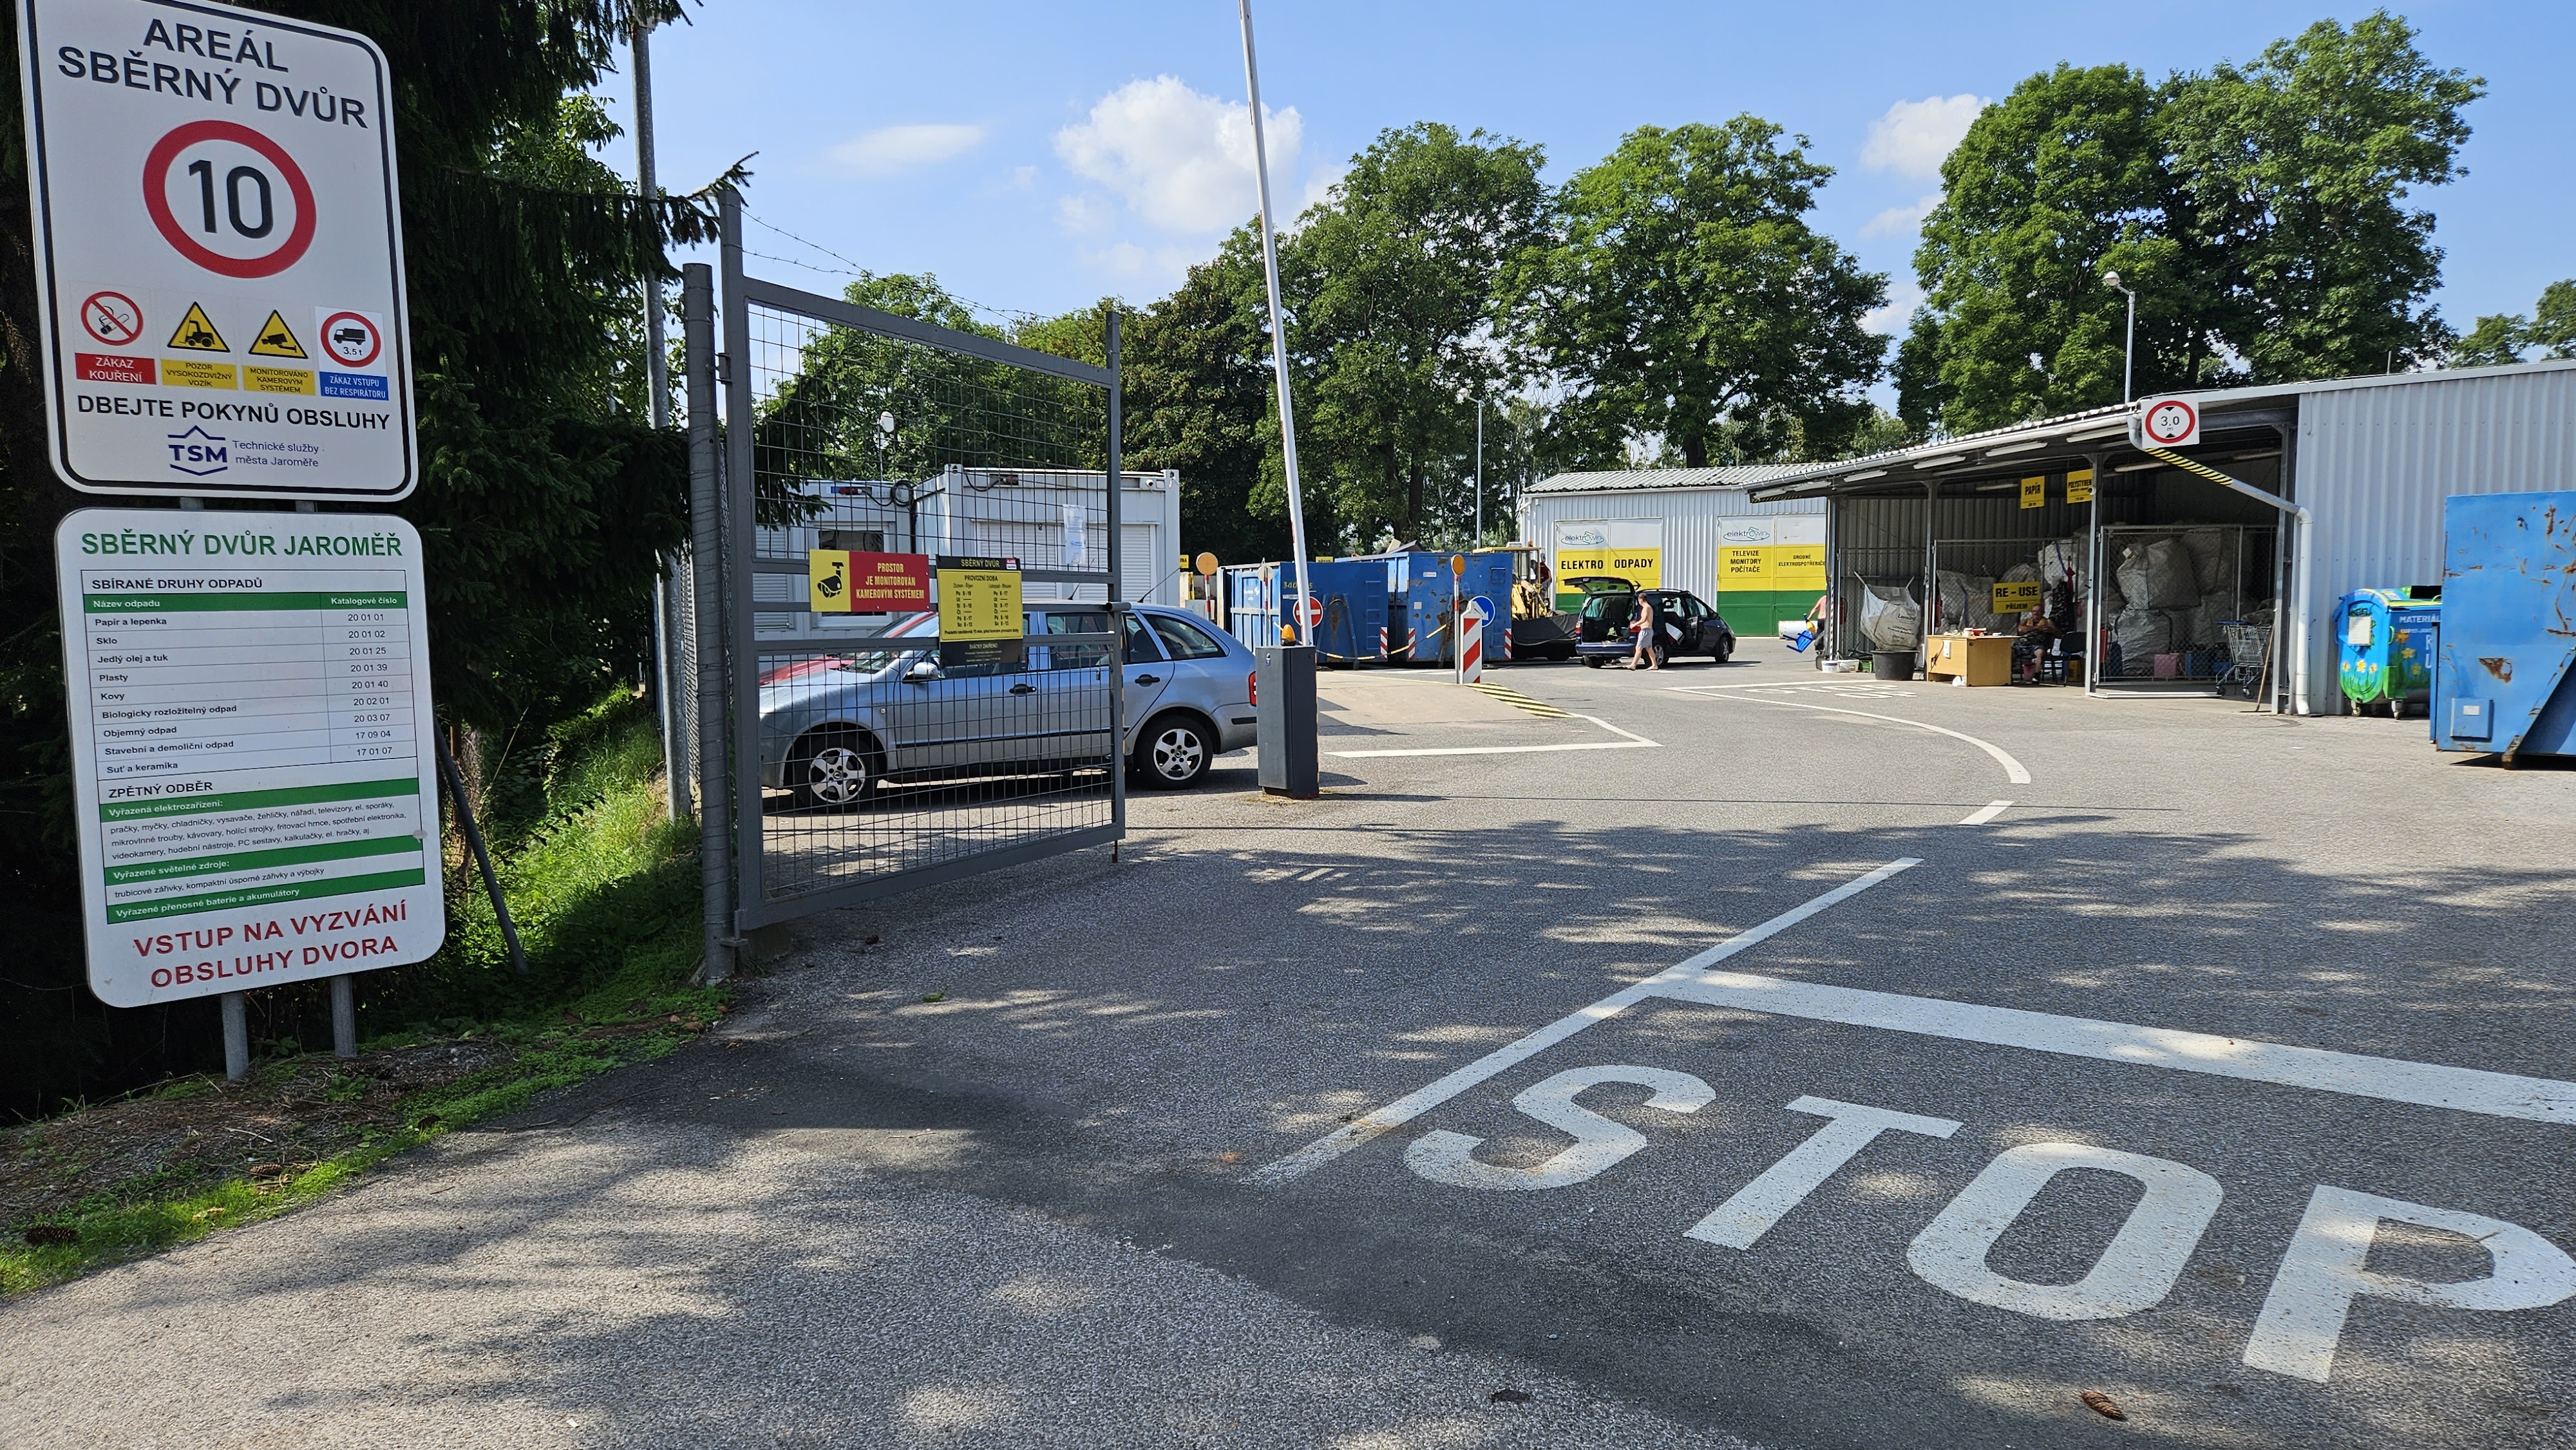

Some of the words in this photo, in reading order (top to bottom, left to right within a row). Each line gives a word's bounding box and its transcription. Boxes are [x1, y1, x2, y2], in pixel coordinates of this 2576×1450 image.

[143, 18, 288, 73] AREÁL
[58, 46, 241, 105] SBĚRNÝ
[256, 81, 368, 129] DVŮR
[189, 160, 273, 239] 10
[343, 346, 357, 355] 3.5
[96, 357, 134, 369] ZÁKAZ
[89, 370, 142, 382] KOUŘENÍ
[166, 370, 232, 380] VYSOKOZDVIŽNÝ
[250, 368, 308, 378] MONITOROVÁNO
[257, 376, 303, 385] KAMEROVÝM
[330, 375, 351, 385] ZÁKAZ
[353, 378, 379, 387] VSTUPU
[260, 384, 301, 393] SYSTÉMEM
[325, 387, 338, 395] BEZ
[340, 388, 385, 398] RESPIRÁTORU
[78, 395, 174, 417] DBEJTE
[182, 401, 278, 423] POKYNŮ
[287, 408, 390, 430] OBSLUHY
[2161, 416, 2179, 426] 3,0
[232, 440, 285, 451] Technické
[287, 443, 319, 454] služby
[168, 444, 227, 463] TSM
[236, 455, 268, 465] města
[271, 457, 318, 467] Jaroměře
[2025, 482, 2041, 495] PAPÍR
[82, 529, 195, 555] SBĚRNÝ
[204, 530, 277, 555] DVŮR
[284, 532, 403, 556] JAROMĚŘ
[877, 563, 904, 573] PROSTOR
[1561, 560, 1604, 570] ELEKTRO
[1615, 559, 1653, 569] ODPADY
[92, 578, 154, 589] SBÍRANÉ
[158, 579, 204, 588] DRUHY
[208, 577, 262, 588] ODPADŮ
[865, 576, 873, 585] JE
[874, 576, 915, 586] MONITOROVÁN
[856, 589, 893, 598] KAMEROVÝM
[894, 589, 924, 599] SYSTÉMEM
[1996, 588, 2009, 598] RE
[2019, 587, 2038, 596] USE
[124, 600, 160, 608] odpadu
[331, 597, 376, 605] Katalogové
[95, 618, 120, 627] Papír
[130, 618, 167, 626] lepenka
[97, 655, 123, 664] Jedlý
[126, 655, 143, 663] olej
[102, 710, 151, 719] Biologicky
[154, 707, 206, 716] rozložitelný
[209, 705, 237, 714] odpad
[103, 728, 145, 738] Objemný
[148, 726, 177, 735] odpad
[105, 746, 146, 755] Stavební
[158, 742, 202, 752] demoliční
[205, 740, 234, 749] odpad
[135, 762, 178, 771] keramika
[109, 783, 162, 798] ZPĚTNÝ
[166, 780, 213, 793] ODBĚR
[109, 806, 152, 817] Vyřazená
[154, 800, 223, 812] elektrozařízení:
[110, 826, 139, 835] pračky,
[142, 823, 169, 831] myčky,
[171, 819, 214, 828] chladničky,
[216, 814, 255, 825] vysavače,
[257, 812, 289, 820] žehličky,
[113, 868, 156, 880] Vyřazené
[158, 864, 197, 874] světelné
[199, 861, 229, 869] zdroje:
[115, 888, 152, 898] trubicové
[154, 885, 184, 893] zářivky,
[186, 878, 227, 889] kompaktní
[229, 875, 260, 884] úsporné
[262, 872, 288, 880] zářivky
[297, 868, 324, 877] výbojky
[116, 906, 158, 918] Vyřazené
[161, 900, 204, 913] přenosné
[206, 896, 237, 906] baterie
[247, 889, 299, 901] akumulátory
[133, 927, 233, 957] VSTUP
[244, 921, 284, 942] NA
[290, 899, 406, 935] VYZVÁNÍ
[151, 950, 293, 987] OBSLUHY
[303, 936, 398, 965] DVORA
[1404, 1064, 2576, 1382] STOP
